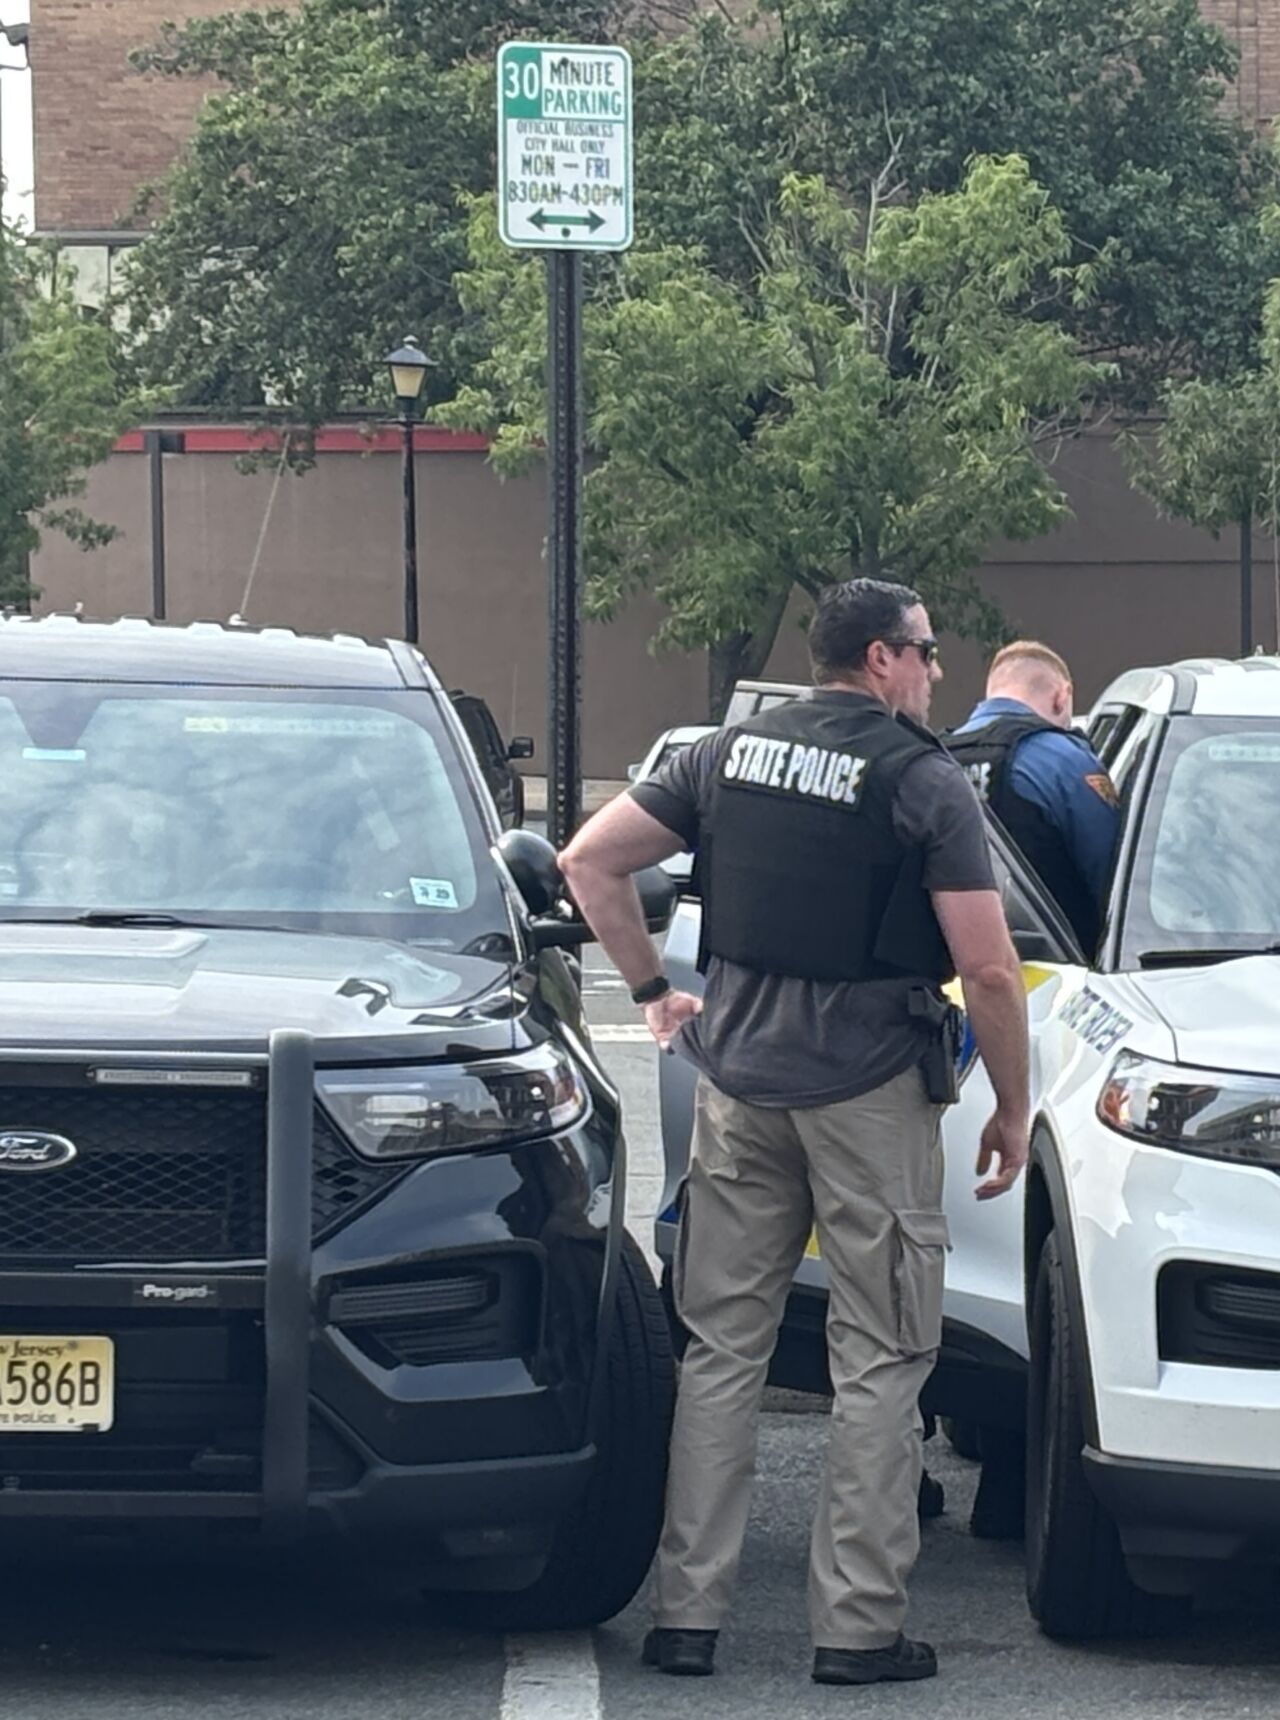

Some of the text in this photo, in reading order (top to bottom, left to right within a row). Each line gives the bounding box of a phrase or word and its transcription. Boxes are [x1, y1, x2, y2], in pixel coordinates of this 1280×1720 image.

[505, 61, 539, 99] 30
[549, 60, 615, 86] MINUTE
[544, 89, 622, 116] PARKING
[516, 120, 614, 138] OFFICIAL BUSINESS
[524, 137, 605, 154] CITY HALL ONLY
[520, 154, 556, 177] MON
[585, 157, 610, 179] FRI
[724, 734, 867, 804] STATE POLICE
[0, 1137, 51, 1160] Ford
[10, 1341, 65, 1358] Jersey
[0, 1360, 100, 1406] 586B
